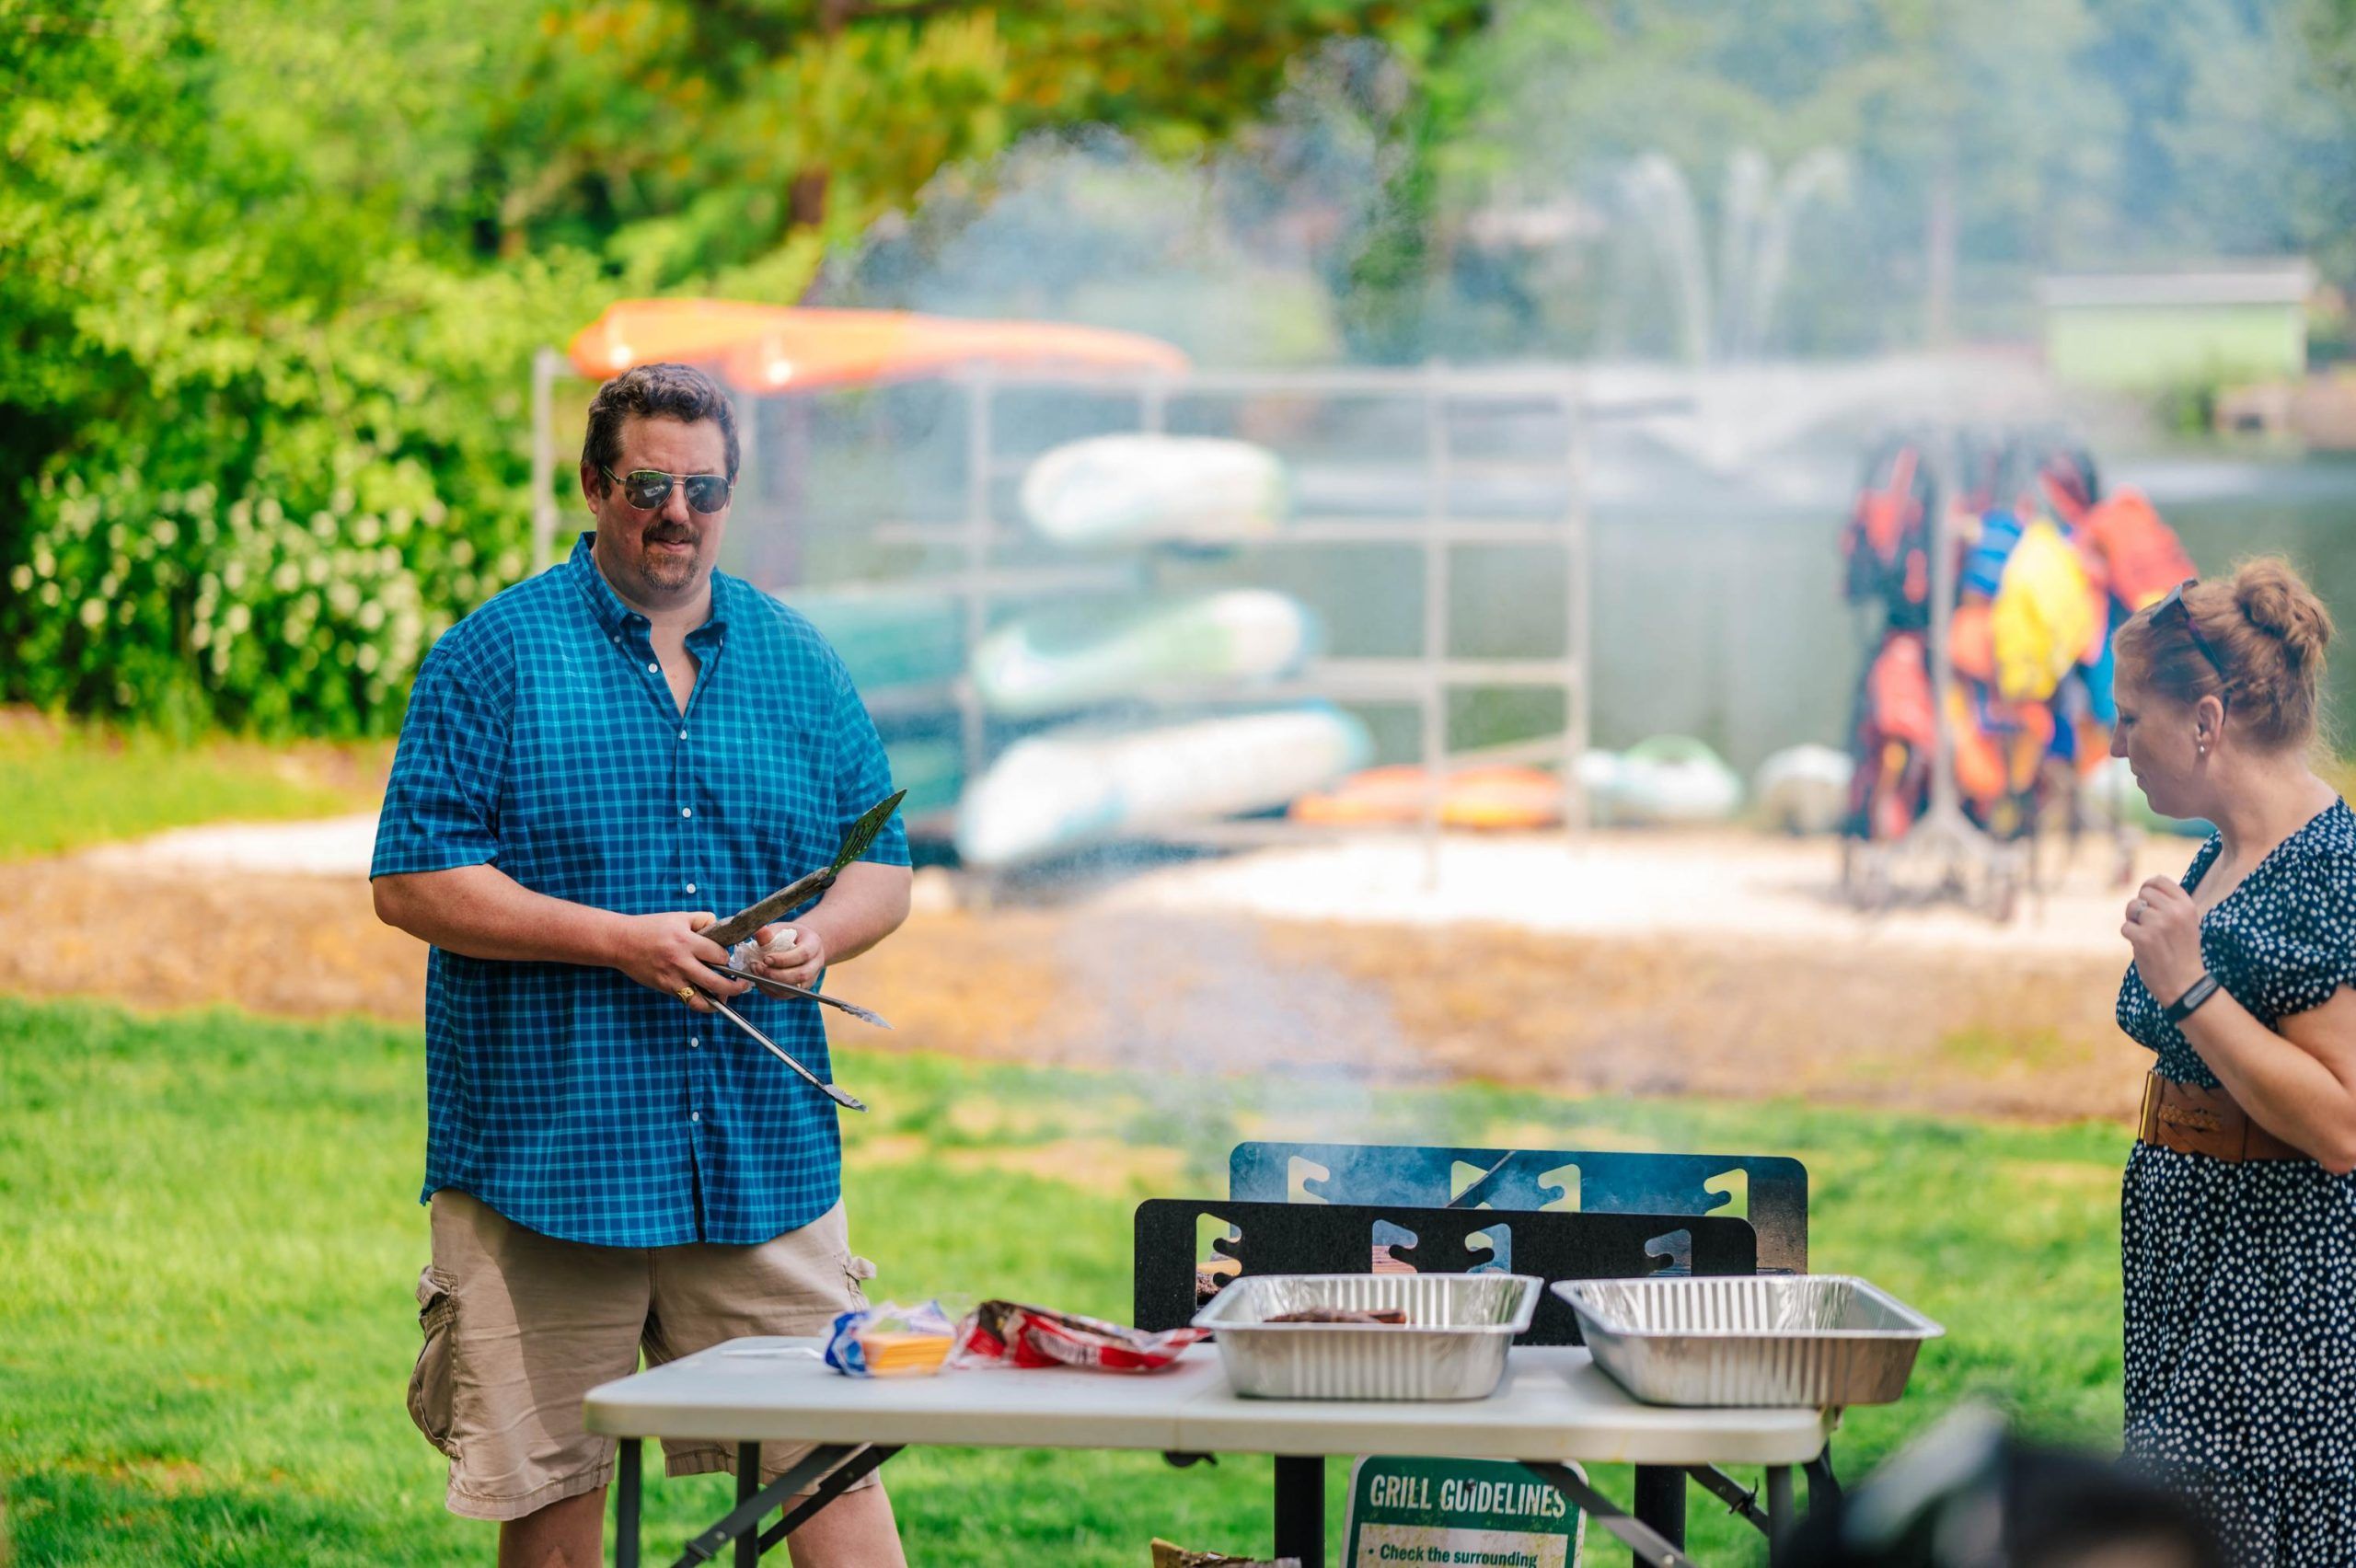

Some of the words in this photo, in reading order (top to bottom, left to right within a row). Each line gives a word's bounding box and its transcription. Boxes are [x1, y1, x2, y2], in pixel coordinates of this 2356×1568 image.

[1369, 1474, 1432, 1510] GRILL
[1439, 1478, 1565, 1518] GUIDELINES
[1380, 1544, 1424, 1562] Check
[1427, 1547, 1450, 1562] the
[1453, 1551, 1538, 1568] surrounding
